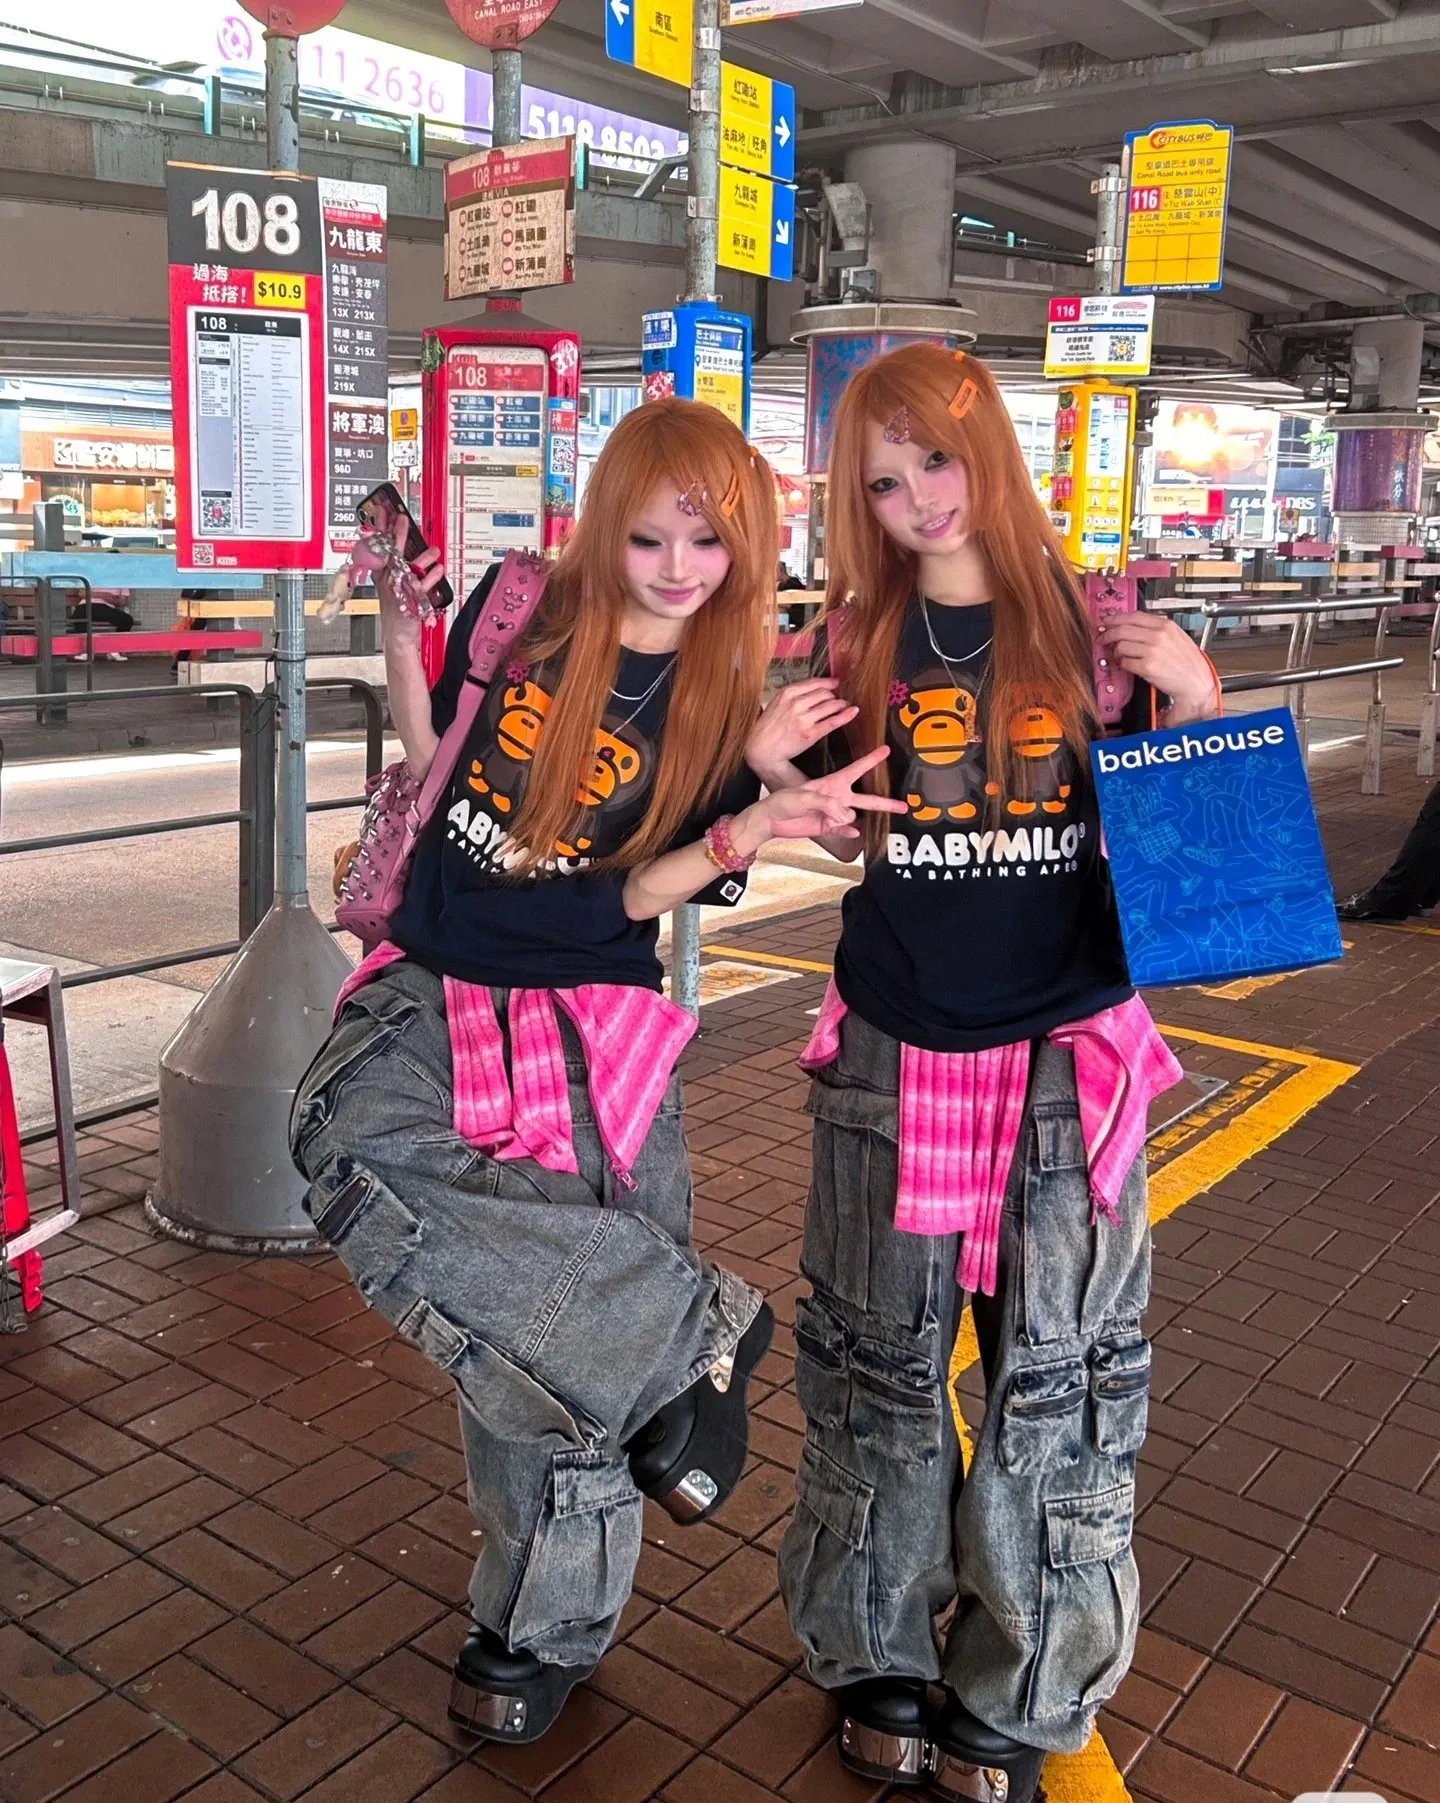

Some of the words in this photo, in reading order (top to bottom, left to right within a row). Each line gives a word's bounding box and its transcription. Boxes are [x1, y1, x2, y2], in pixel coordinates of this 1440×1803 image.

[474, 8, 498, 20] CANAL
[501, 2, 521, 14] ROAD
[655, 11, 672, 32] 南區
[364, 57, 445, 113] 2636
[472, 166, 490, 189] 108
[495, 187, 509, 199] VIA
[1133, 189, 1159, 210] 116
[191, 188, 300, 255] 108
[329, 225, 384, 254] 九龍東
[192, 262, 228, 282] 過海
[258, 280, 302, 299] $10.9
[332, 307, 349, 318] 13X
[354, 309, 375, 321] 213X
[1056, 304, 1075, 317] 116
[201, 316, 227, 330] 108
[333, 344, 350, 355] 14X
[354, 345, 376, 357] 215X
[455, 365, 487, 387] 108
[333, 381, 356, 392] 219X
[332, 411, 385, 435] 將軍澳
[1393, 469, 1404, 498] 秋分
[1286, 496, 1316, 510] DBS
[334, 512, 355, 522] 296D
[1097, 725, 1285, 773] bakehouse
[928, 865, 1027, 880] BATHING
